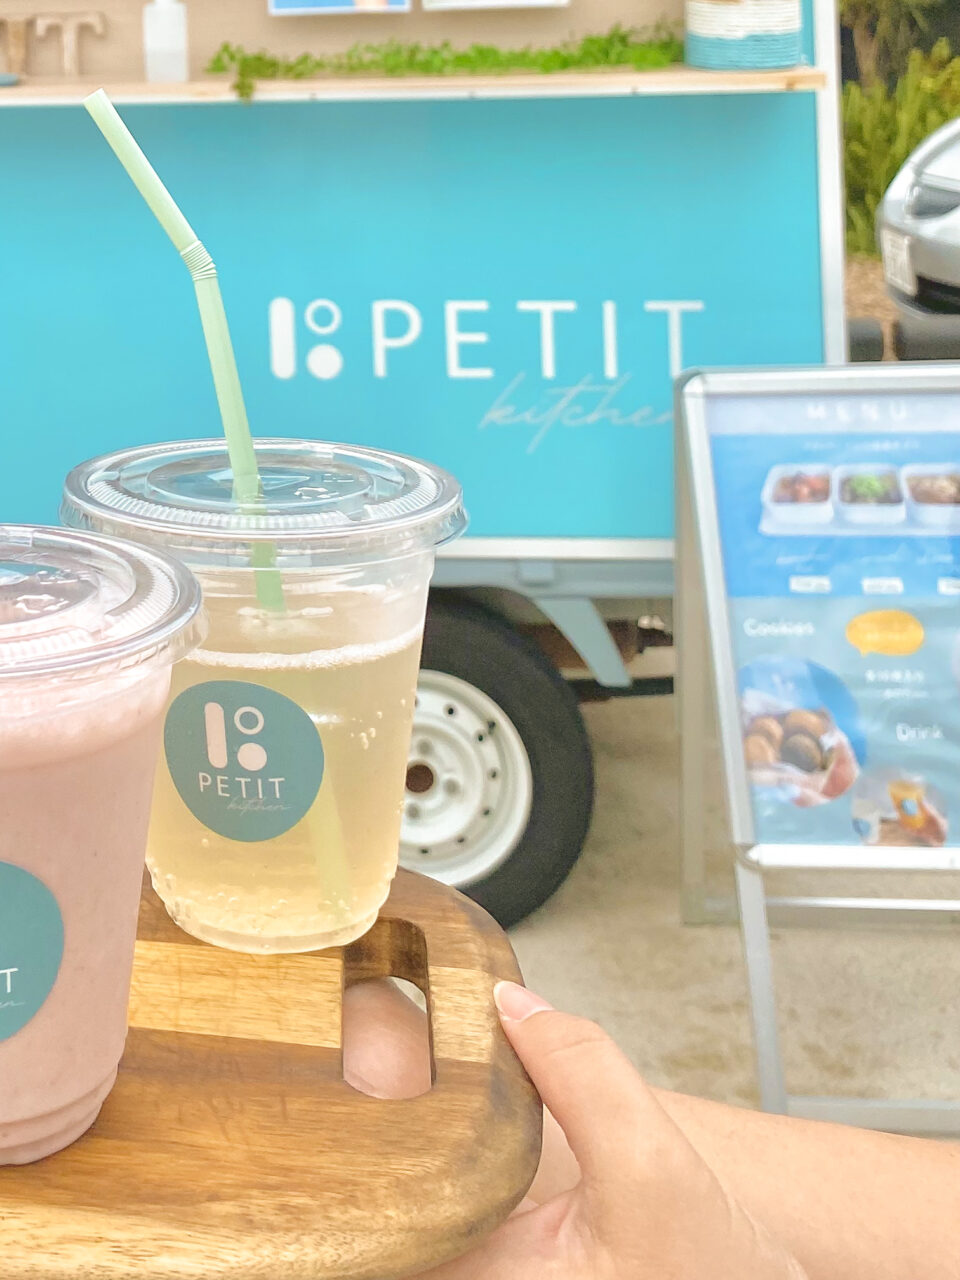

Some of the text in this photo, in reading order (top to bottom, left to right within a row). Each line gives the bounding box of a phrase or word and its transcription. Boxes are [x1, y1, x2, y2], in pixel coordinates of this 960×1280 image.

[370, 299, 705, 379] PETIT
[742, 617, 816, 637] Cookies
[198, 771, 286, 799] PETIT
